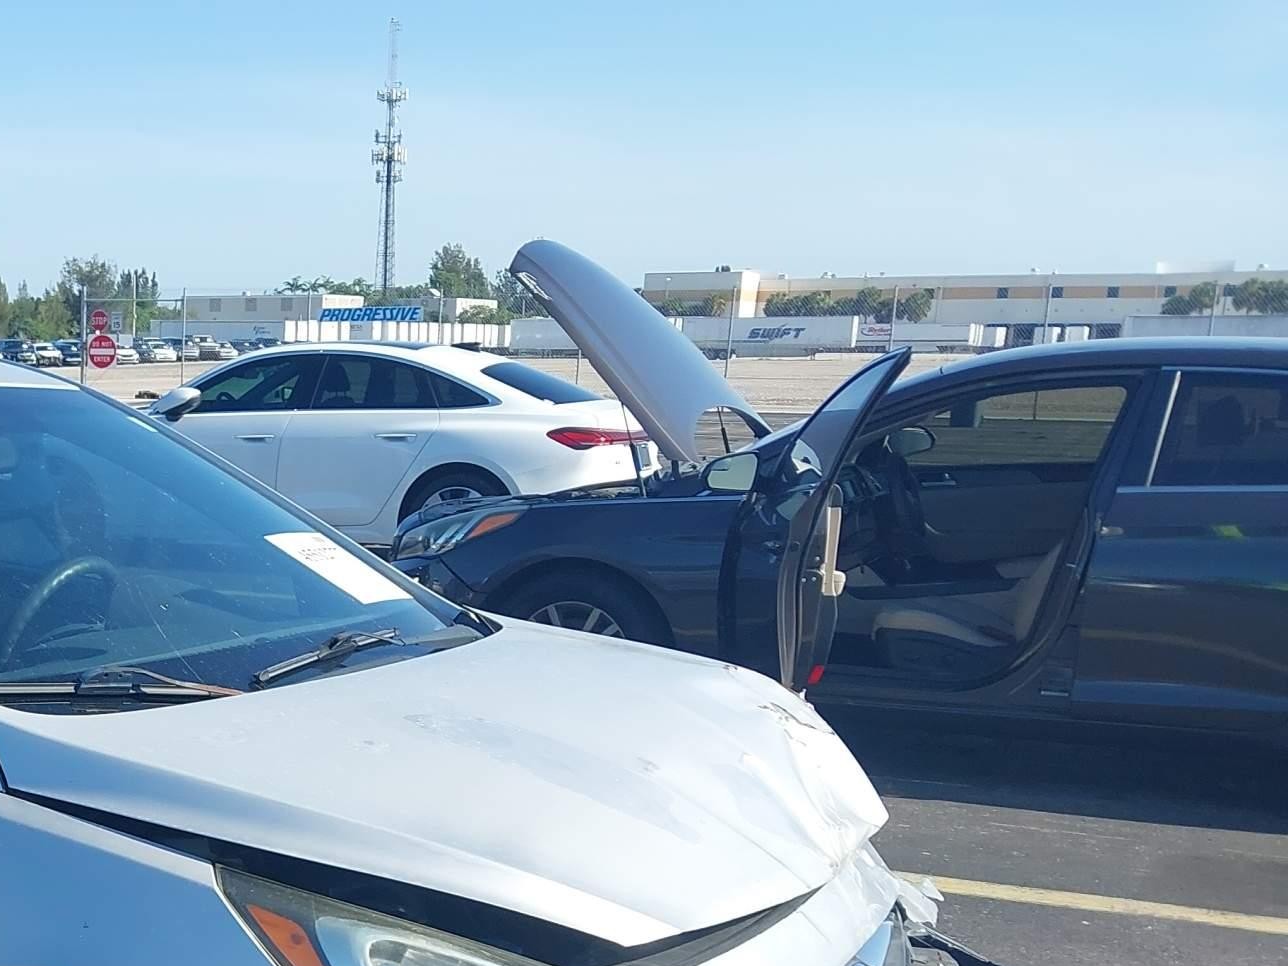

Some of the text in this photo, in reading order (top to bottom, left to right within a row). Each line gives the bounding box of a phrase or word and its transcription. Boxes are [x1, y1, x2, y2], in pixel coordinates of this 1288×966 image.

[320, 307, 421, 322] PROGRESSIVE
[92, 317, 107, 325] STOP
[113, 321, 121, 329] 15
[748, 327, 807, 340] SWIFT
